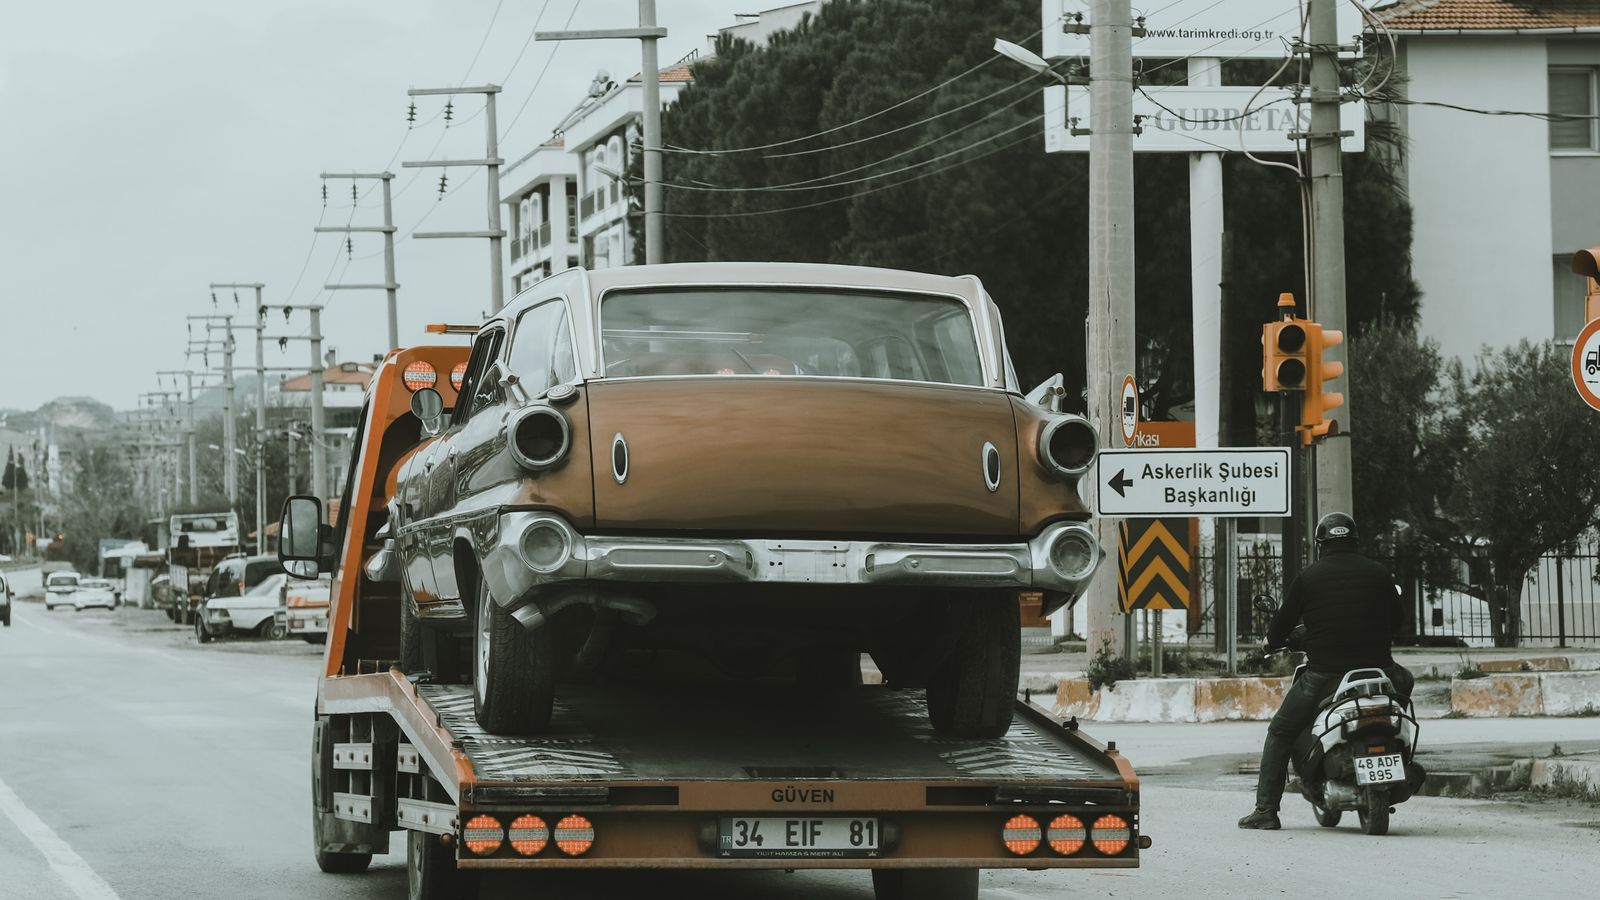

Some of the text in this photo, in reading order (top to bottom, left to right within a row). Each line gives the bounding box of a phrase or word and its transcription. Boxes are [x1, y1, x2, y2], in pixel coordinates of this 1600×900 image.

[1146, 28, 1274, 42] www.tarimkredi.org.tr
[1142, 462, 1279, 482] Askerlik Şubesi
[1164, 487, 1256, 507] Başkanlığı
[1358, 756, 1400, 769] 48 ADF
[1369, 769, 1393, 782] 895
[771, 786, 835, 803] GÜVEN
[721, 835, 732, 844] TR
[735, 820, 874, 847] 34 EIF 81
